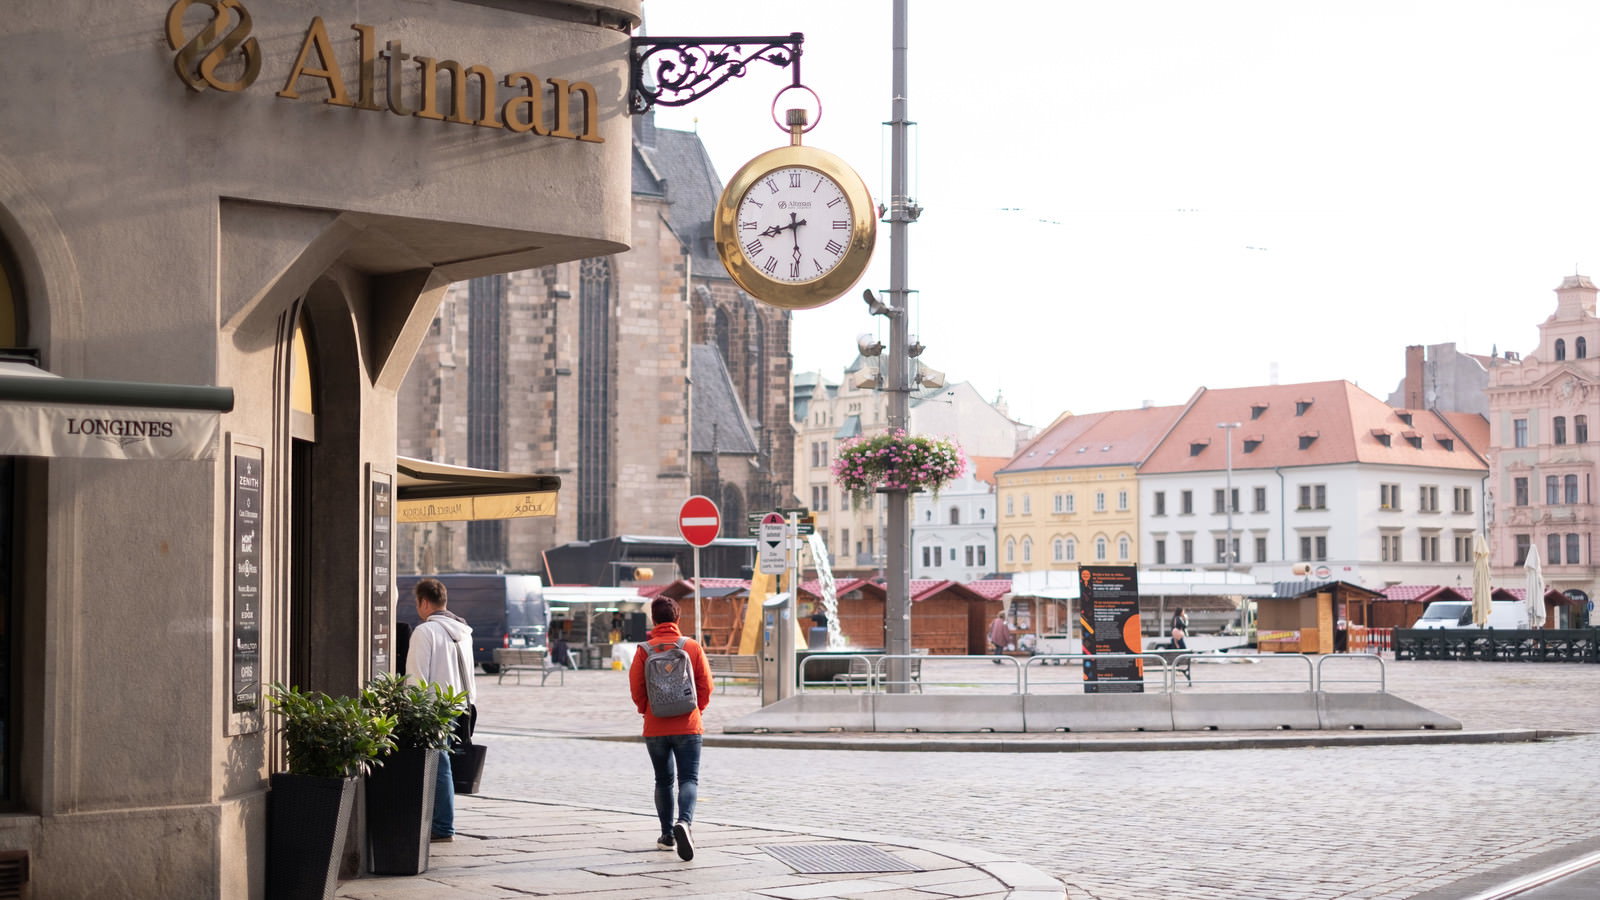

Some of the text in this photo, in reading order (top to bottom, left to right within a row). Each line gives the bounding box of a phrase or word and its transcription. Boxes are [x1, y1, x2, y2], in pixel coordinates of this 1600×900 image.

[276, 15, 606, 144] Altman
[789, 173, 801, 188] XII
[67, 418, 173, 438] LONGINES
[239, 476, 259, 487] ZENITH
